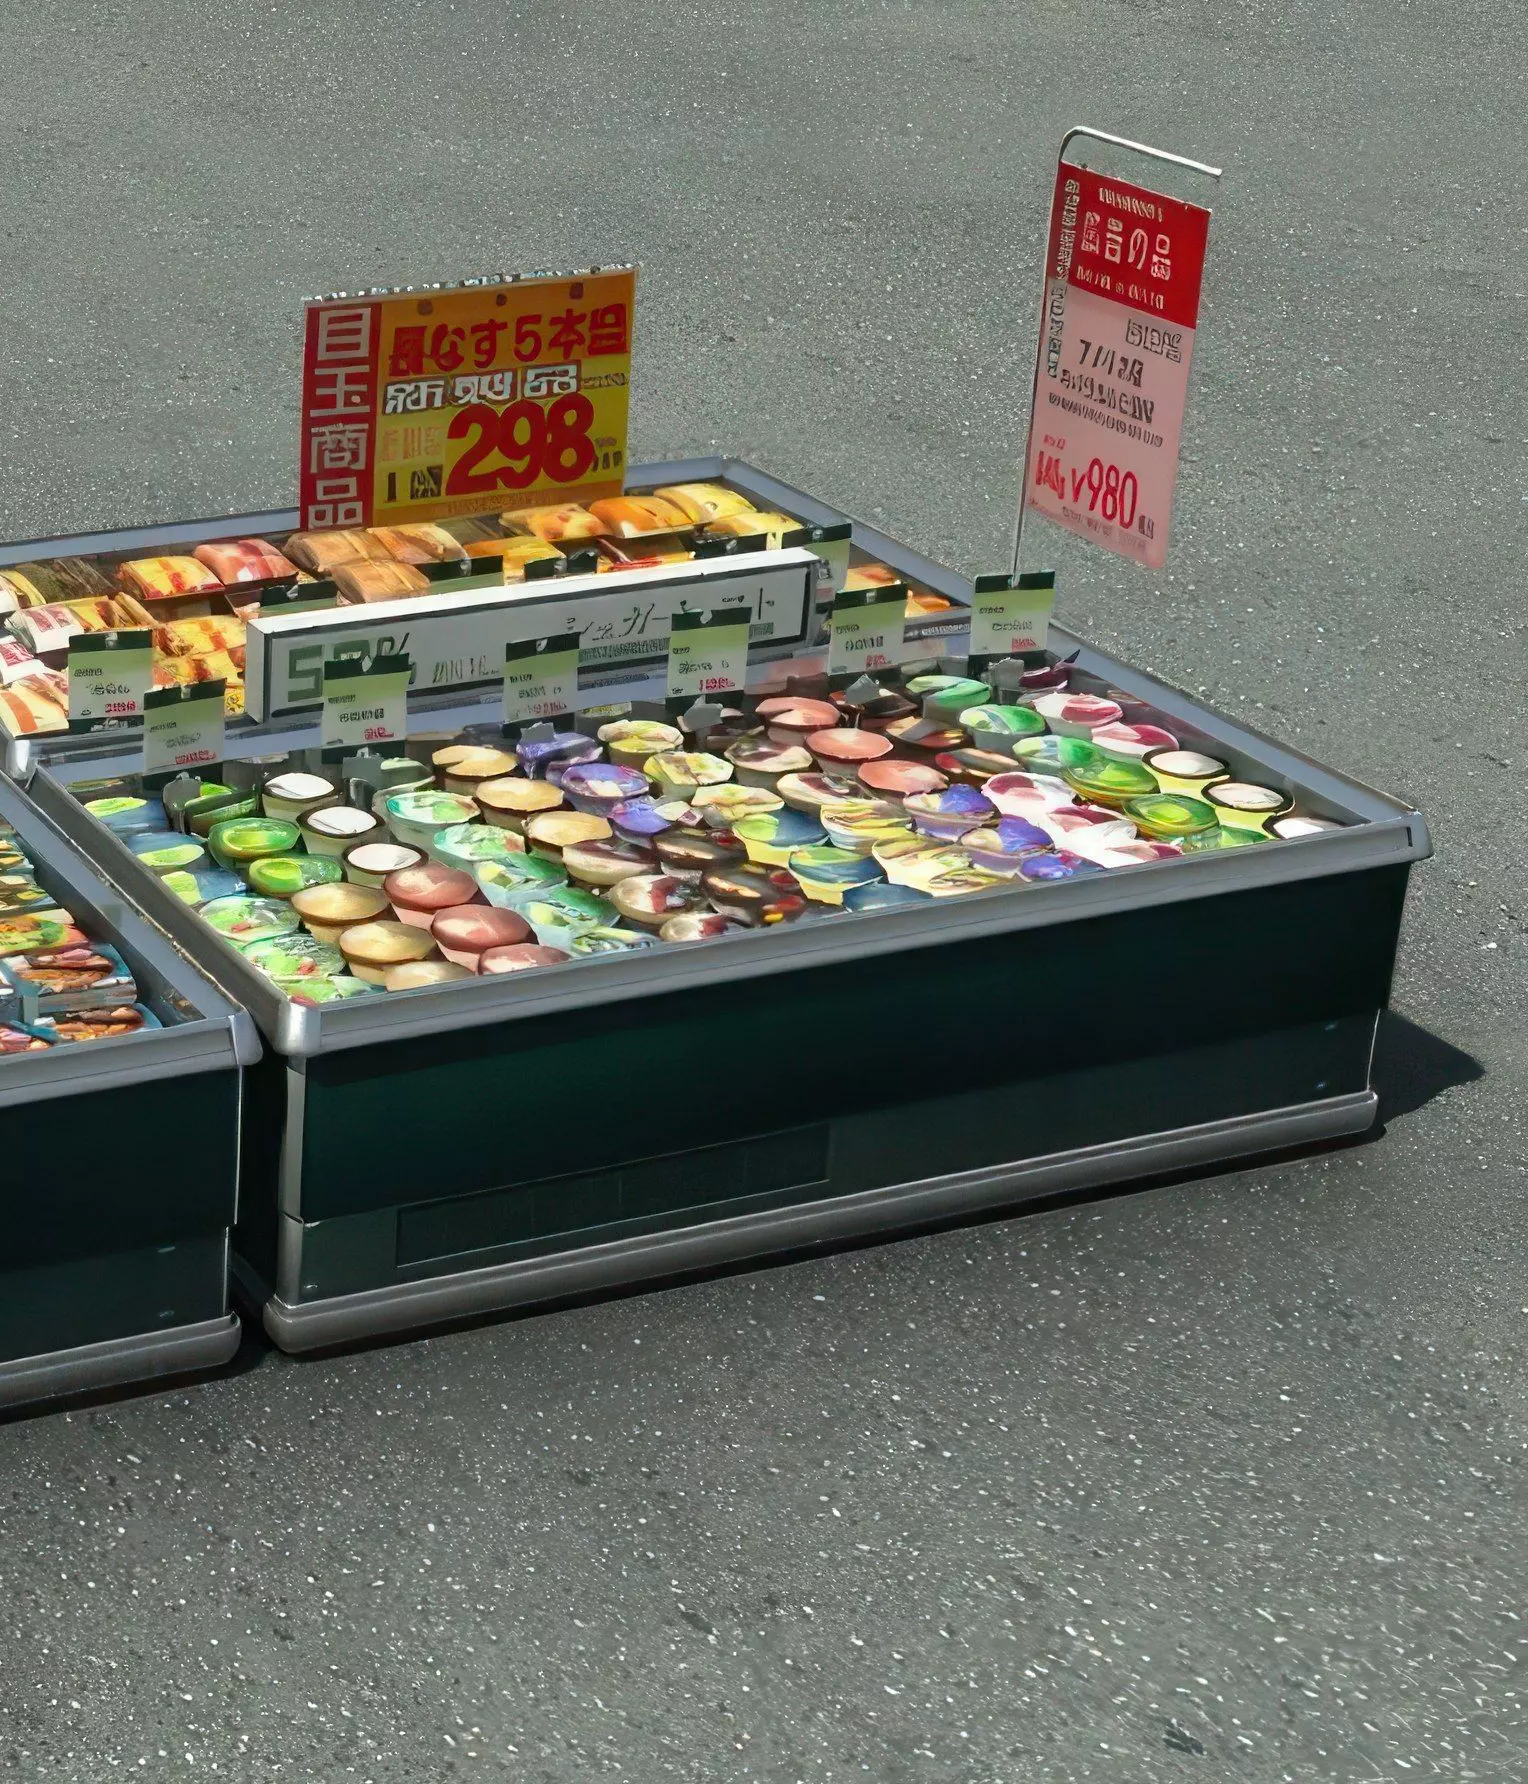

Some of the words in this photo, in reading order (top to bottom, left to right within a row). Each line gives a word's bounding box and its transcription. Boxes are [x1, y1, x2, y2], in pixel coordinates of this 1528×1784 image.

[308, 307, 371, 529] 目玉商品
[445, 393, 594, 496] 298
